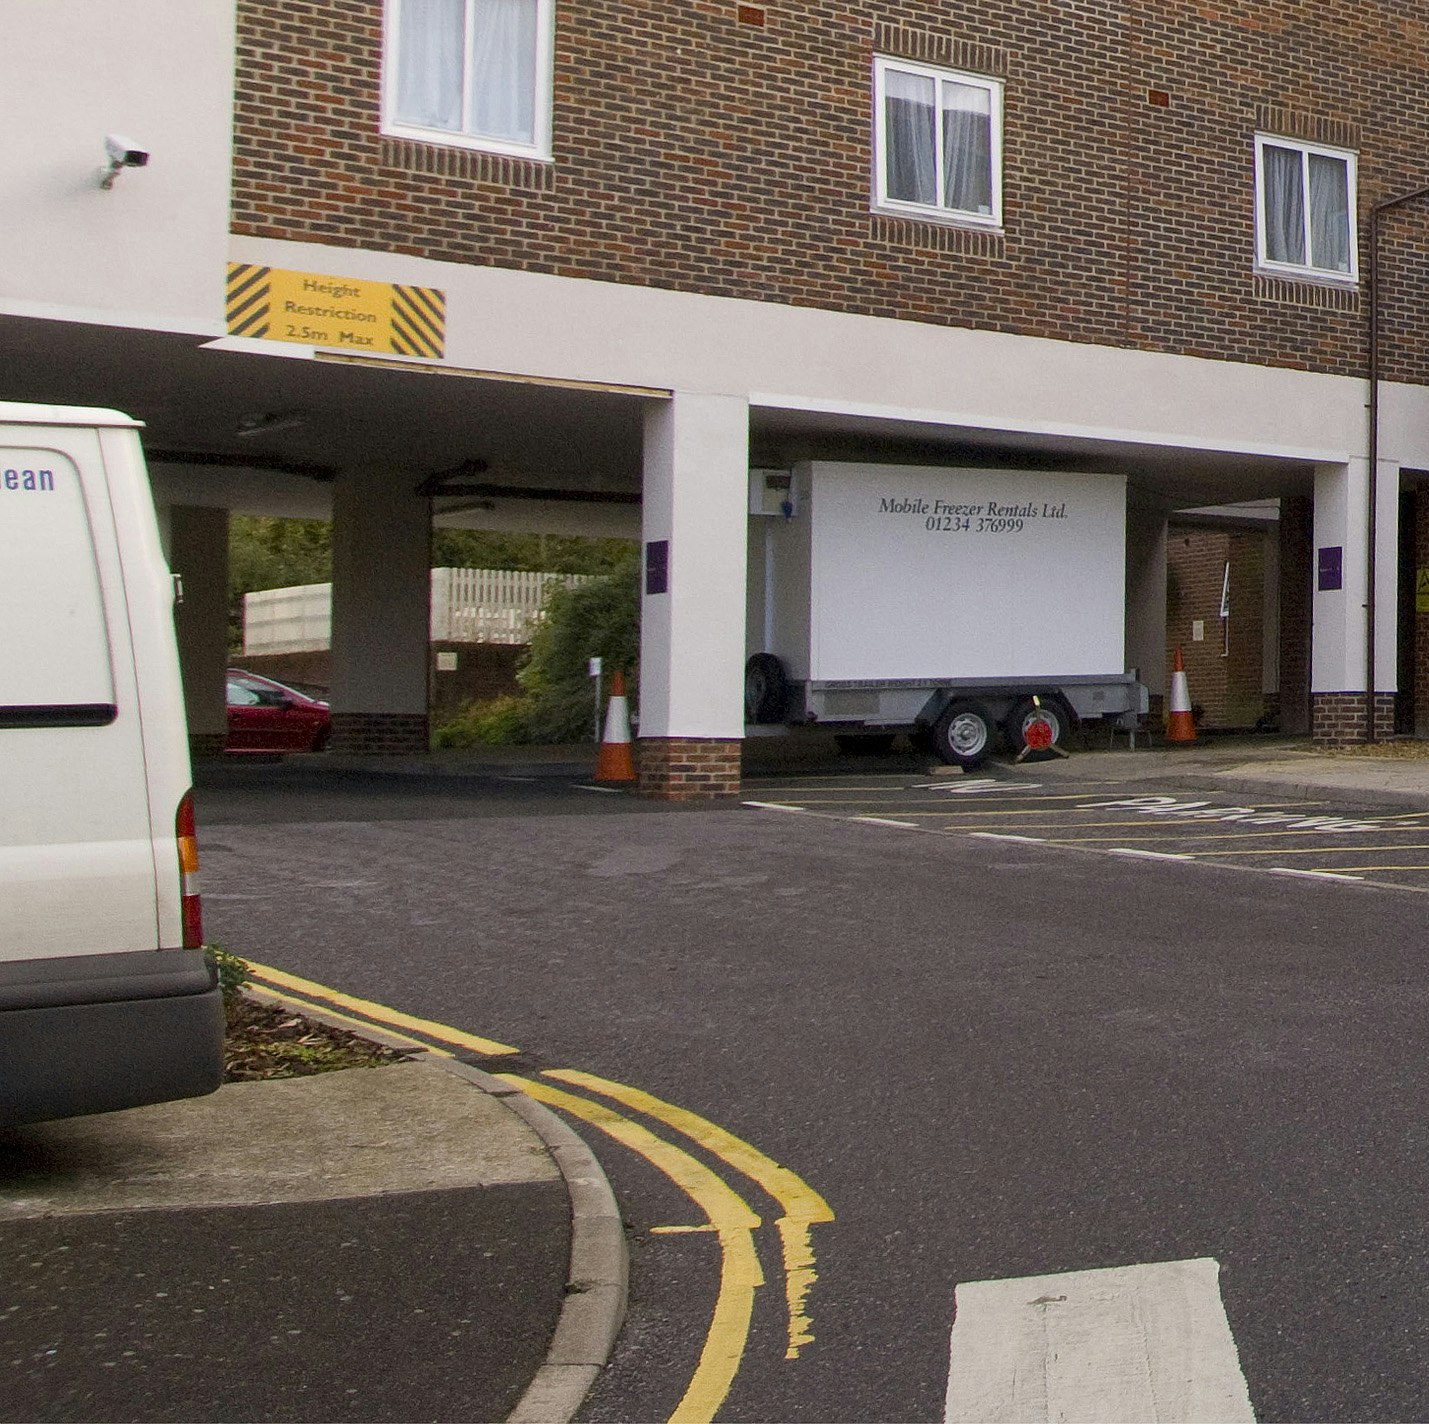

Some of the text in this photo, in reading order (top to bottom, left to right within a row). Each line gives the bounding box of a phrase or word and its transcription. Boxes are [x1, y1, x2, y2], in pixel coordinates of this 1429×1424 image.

[303, 279, 361, 298] Height
[285, 301, 377, 323] Restriction
[286, 325, 374, 346] 2.5m Max
[0, 468, 54, 490] ean
[879, 498, 929, 515] Mobile
[934, 500, 984, 516] Freezer
[987, 502, 1038, 518] Rentals
[925, 516, 1024, 533] 01234 376999
